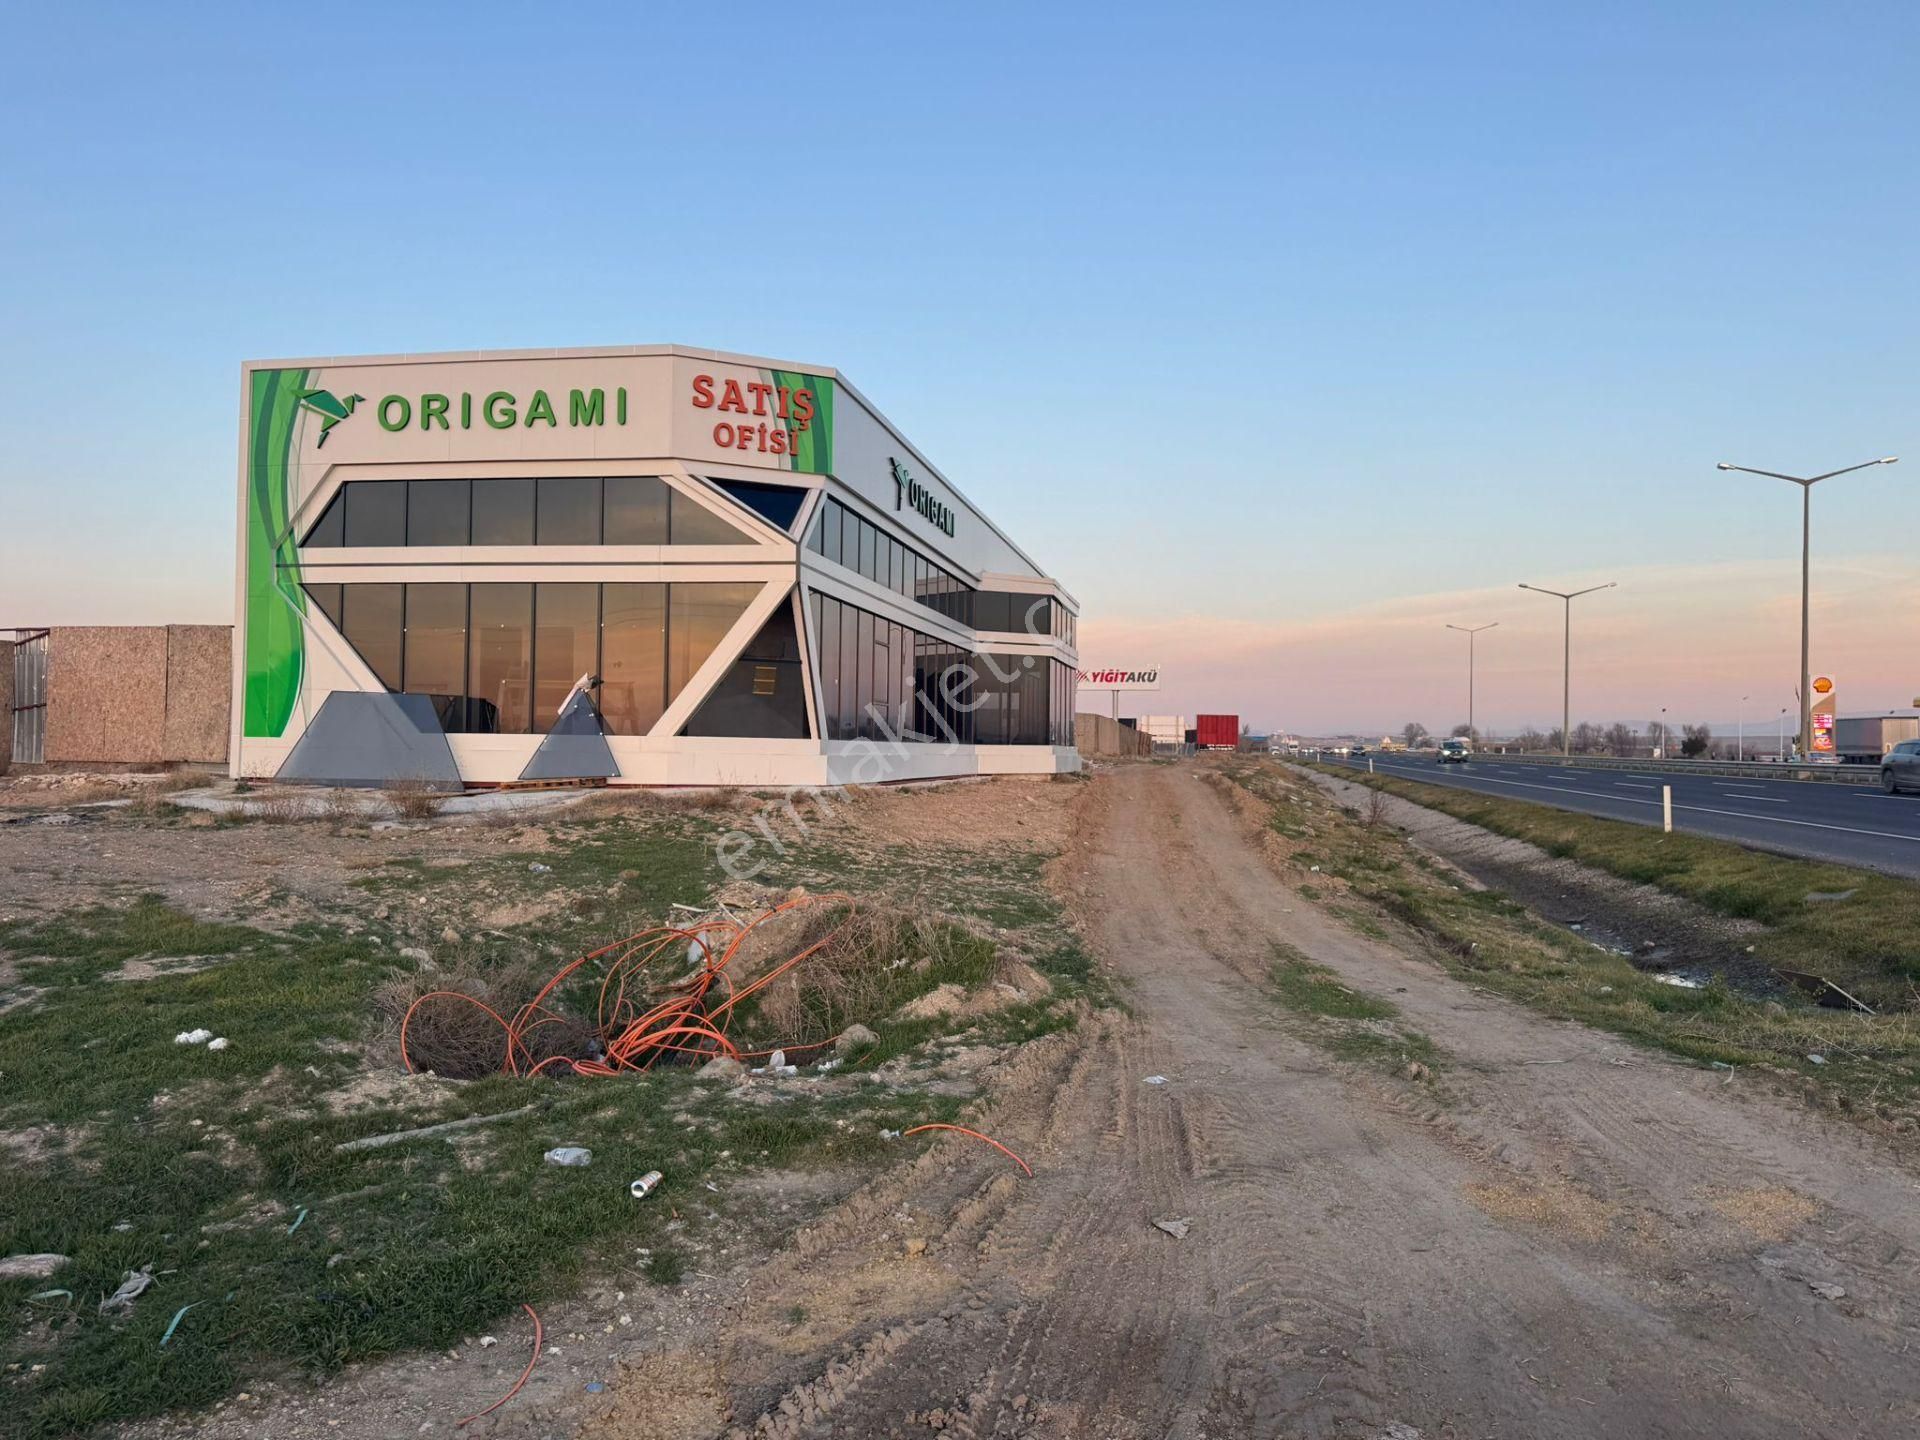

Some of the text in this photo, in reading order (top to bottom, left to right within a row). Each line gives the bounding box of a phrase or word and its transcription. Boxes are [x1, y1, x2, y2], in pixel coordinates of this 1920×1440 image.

[377, 387, 627, 432] ORIGAMI
[692, 375, 815, 431] SATIŞ
[713, 422, 799, 457] OFİSİ
